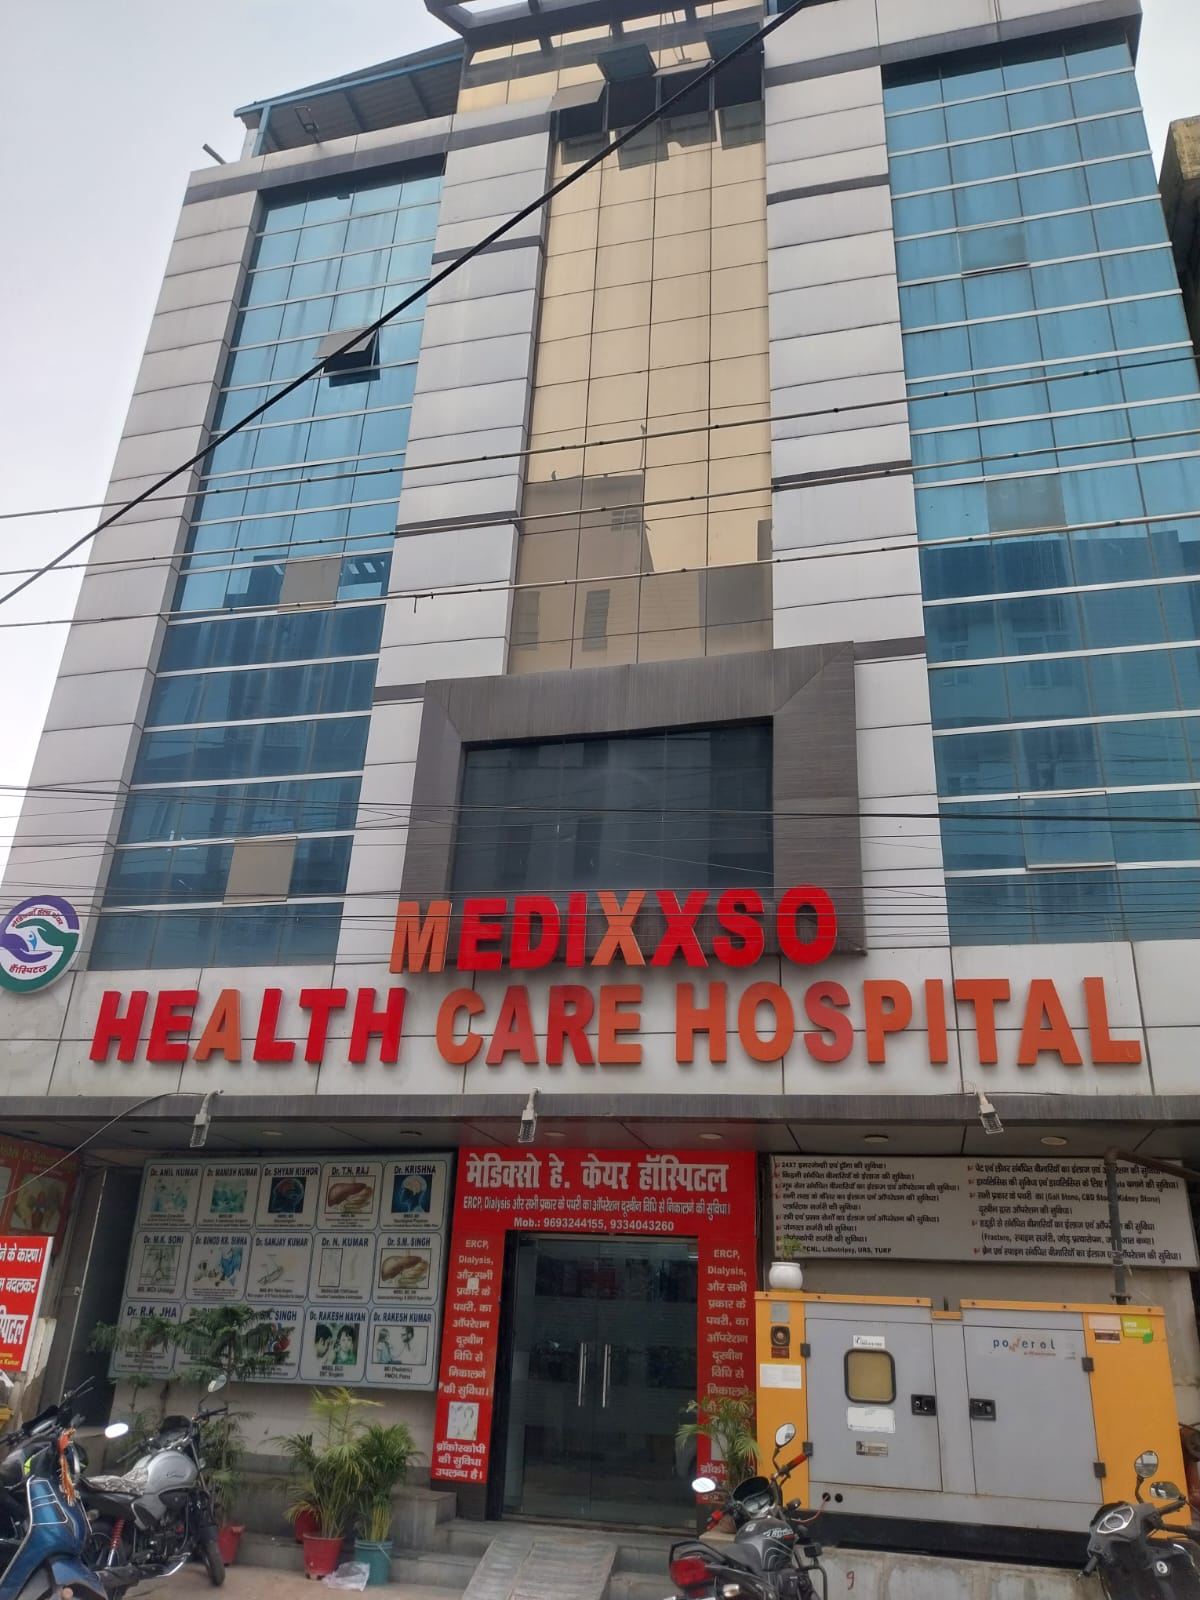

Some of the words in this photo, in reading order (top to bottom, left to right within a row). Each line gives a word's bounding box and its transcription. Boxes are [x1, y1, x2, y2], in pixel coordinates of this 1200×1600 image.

[390, 884, 837, 974] MEDIXXSO
[89, 988, 406, 1063] HEALTH
[436, 984, 642, 1066] CARE
[676, 977, 1142, 1066] HOSPITAL
[405, 1165, 436, 1174] KRISHNA
[466, 1153, 542, 1188] मेडिक्सो
[549, 1153, 570, 1188] हे.
[580, 1153, 631, 1189] केयर
[638, 1154, 729, 1192] हॉस्पिटल
[514, 1217, 540, 1227] Mob.:
[544, 1217, 606, 1229] 9693244155,
[610, 1219, 674, 1231] 9334043260
[343, 1238, 369, 1247] KUMAR
[465, 1240, 489, 1250] ERCP,
[7, 1242, 17, 1262] के
[713, 1249, 740, 1260] ERCP,
[6, 1278, 38, 1294] बदलकर
[160, 1307, 177, 1317] JHA
[275, 1311, 297, 1321] SINGH
[318, 1311, 344, 1321] RAKESH
